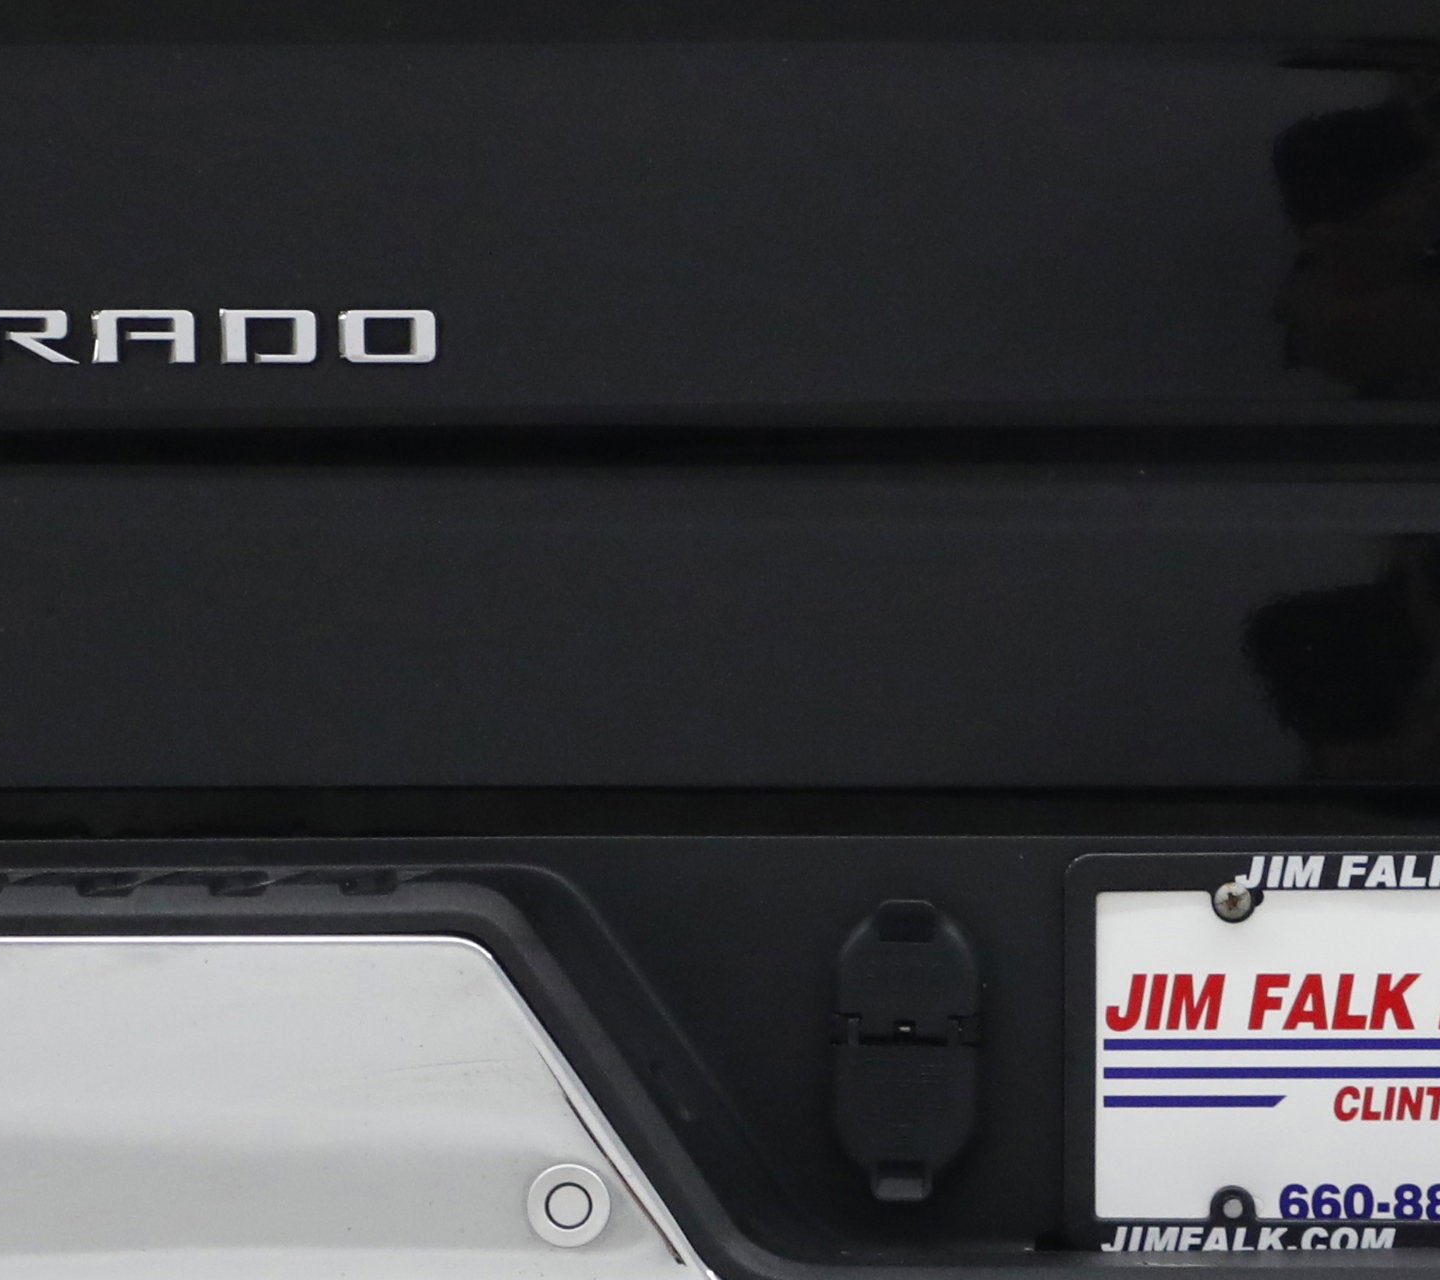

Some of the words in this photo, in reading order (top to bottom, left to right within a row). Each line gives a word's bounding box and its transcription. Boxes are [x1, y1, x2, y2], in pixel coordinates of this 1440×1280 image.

[1235, 855, 1325, 889] JIM
[1106, 973, 1226, 1032] JIM
[1249, 973, 1422, 1032] FALK
[1100, 1226, 1396, 1252] JIMFALK.COM
